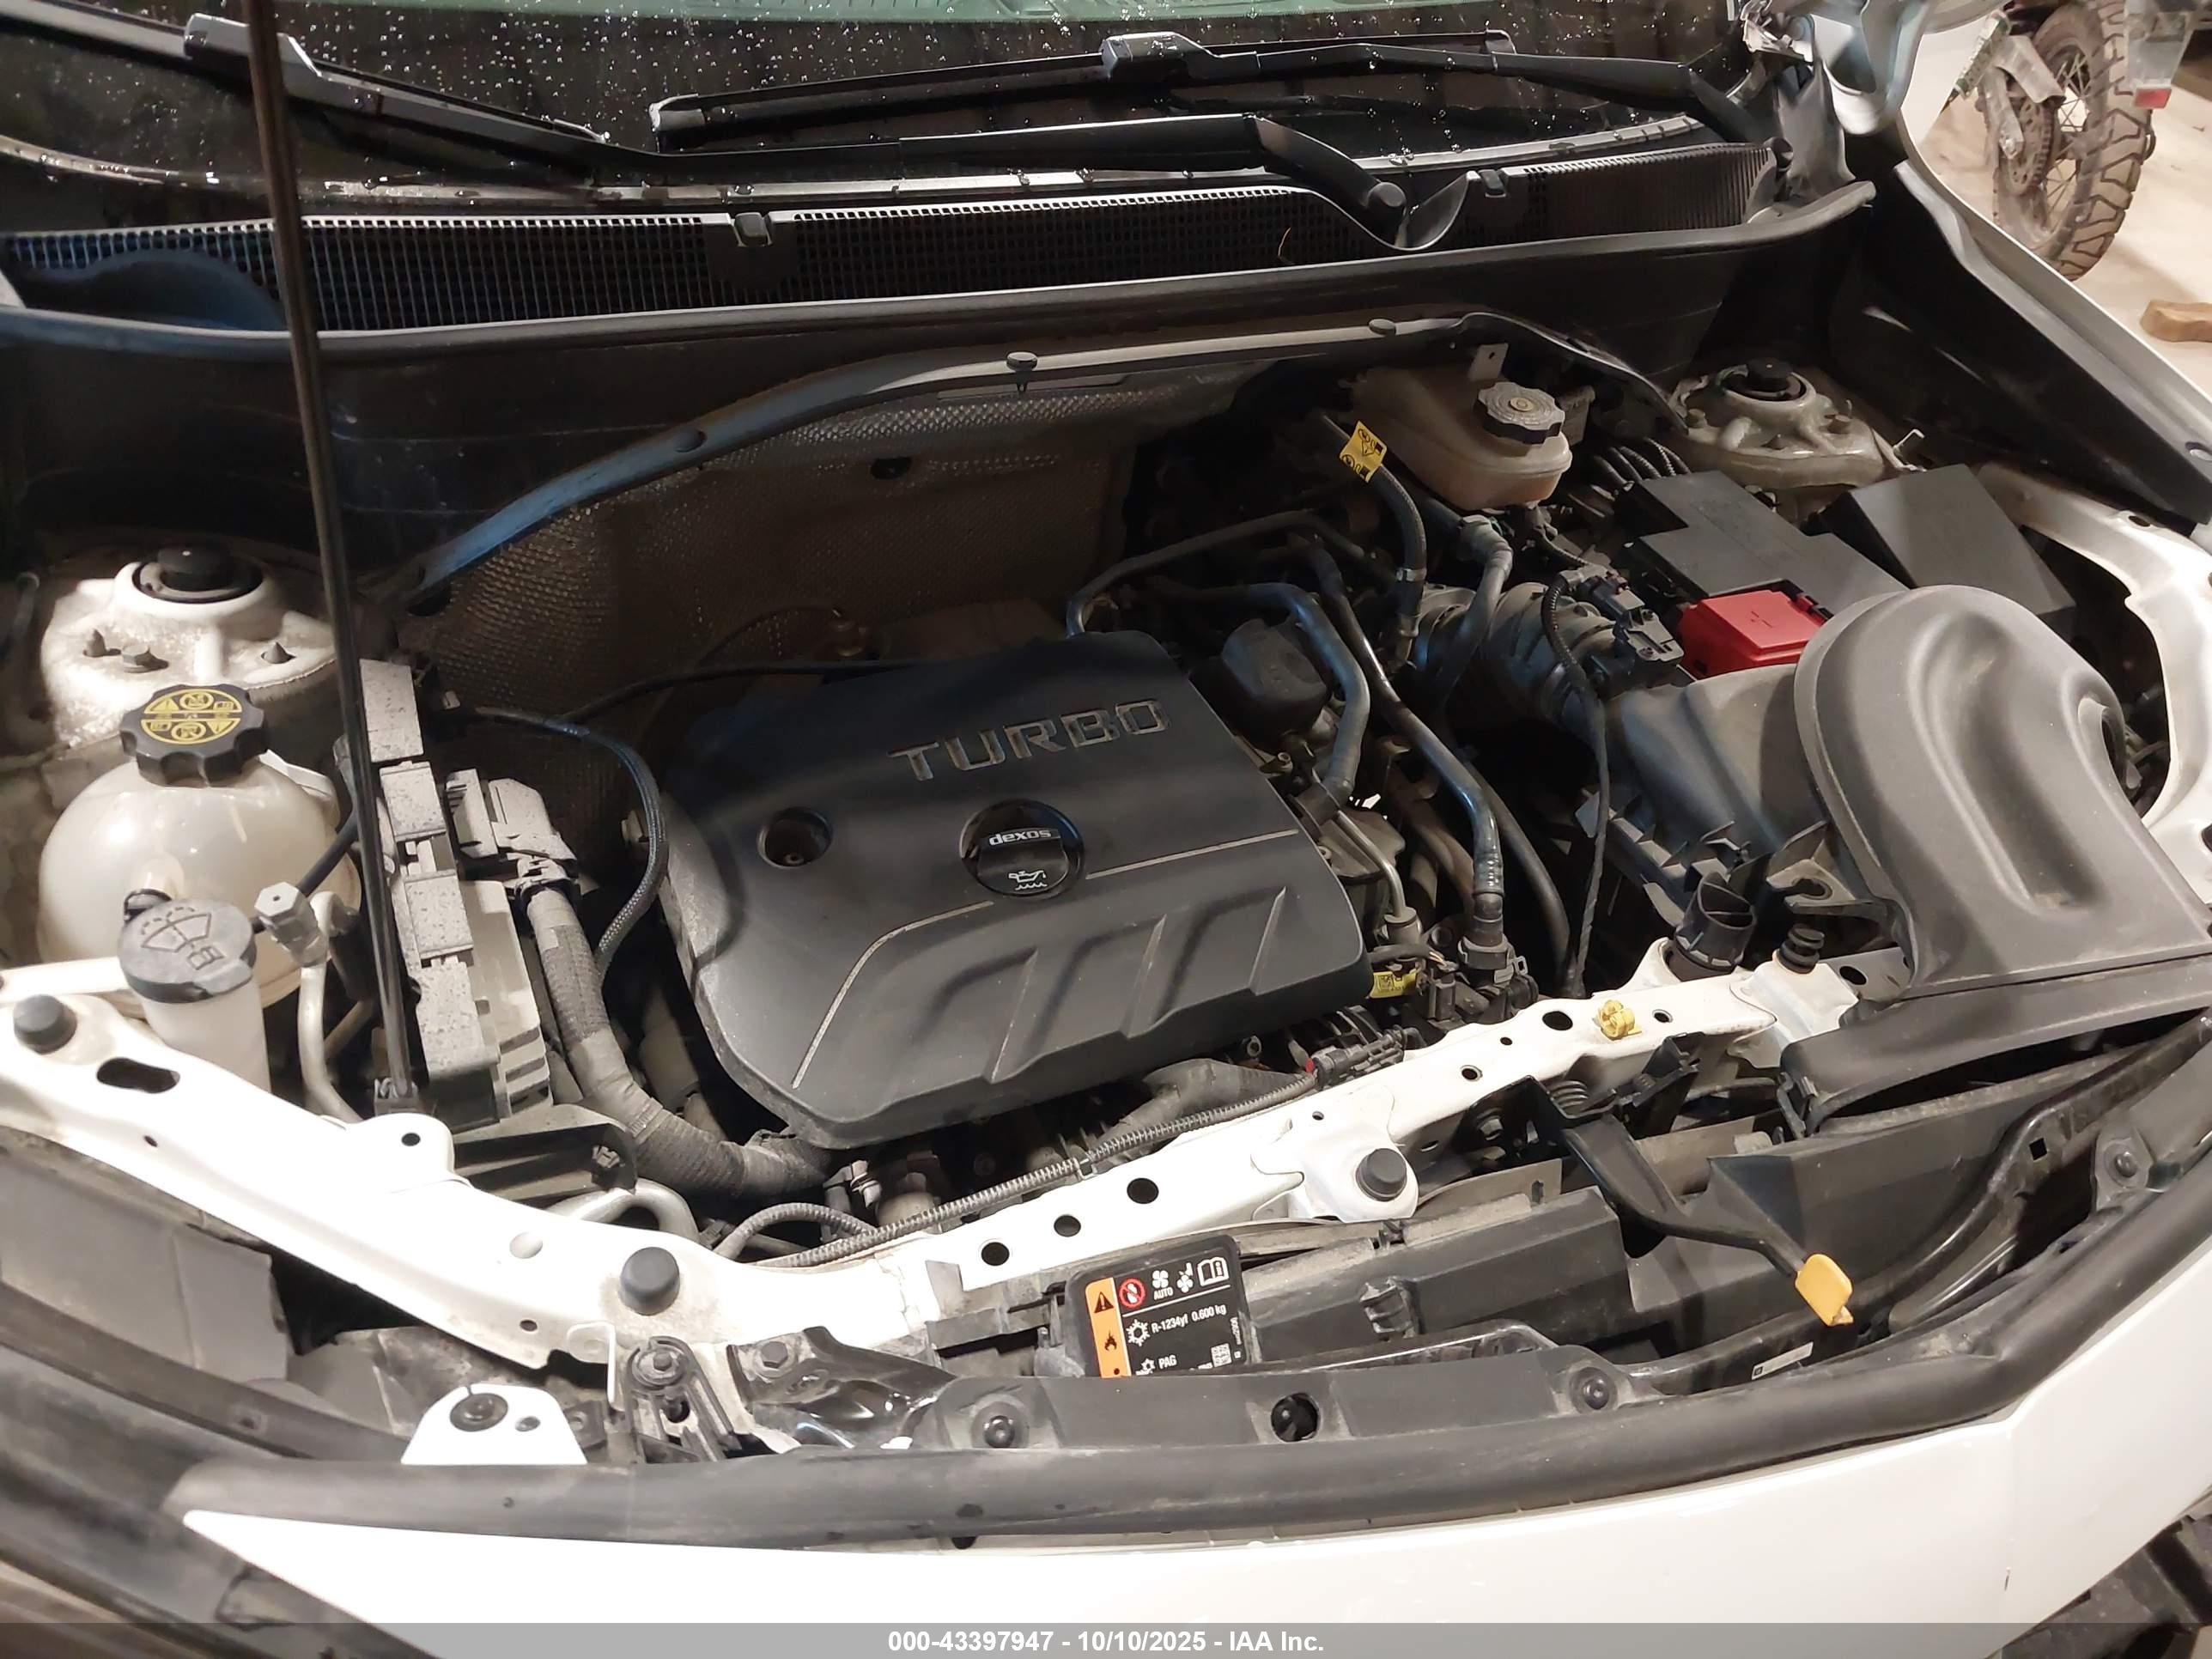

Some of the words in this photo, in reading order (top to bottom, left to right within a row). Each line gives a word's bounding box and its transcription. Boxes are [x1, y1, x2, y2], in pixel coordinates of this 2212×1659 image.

[888, 699, 1170, 781] TURBO
[989, 830, 1052, 846] dexos
[1153, 1286, 1174, 1300] AUTO
[1152, 1314, 1188, 1334] R-1234yf
[1192, 1307, 1214, 1322] 0.600
[1214, 1304, 1227, 1316] kg
[1158, 1354, 1177, 1370] PAG
